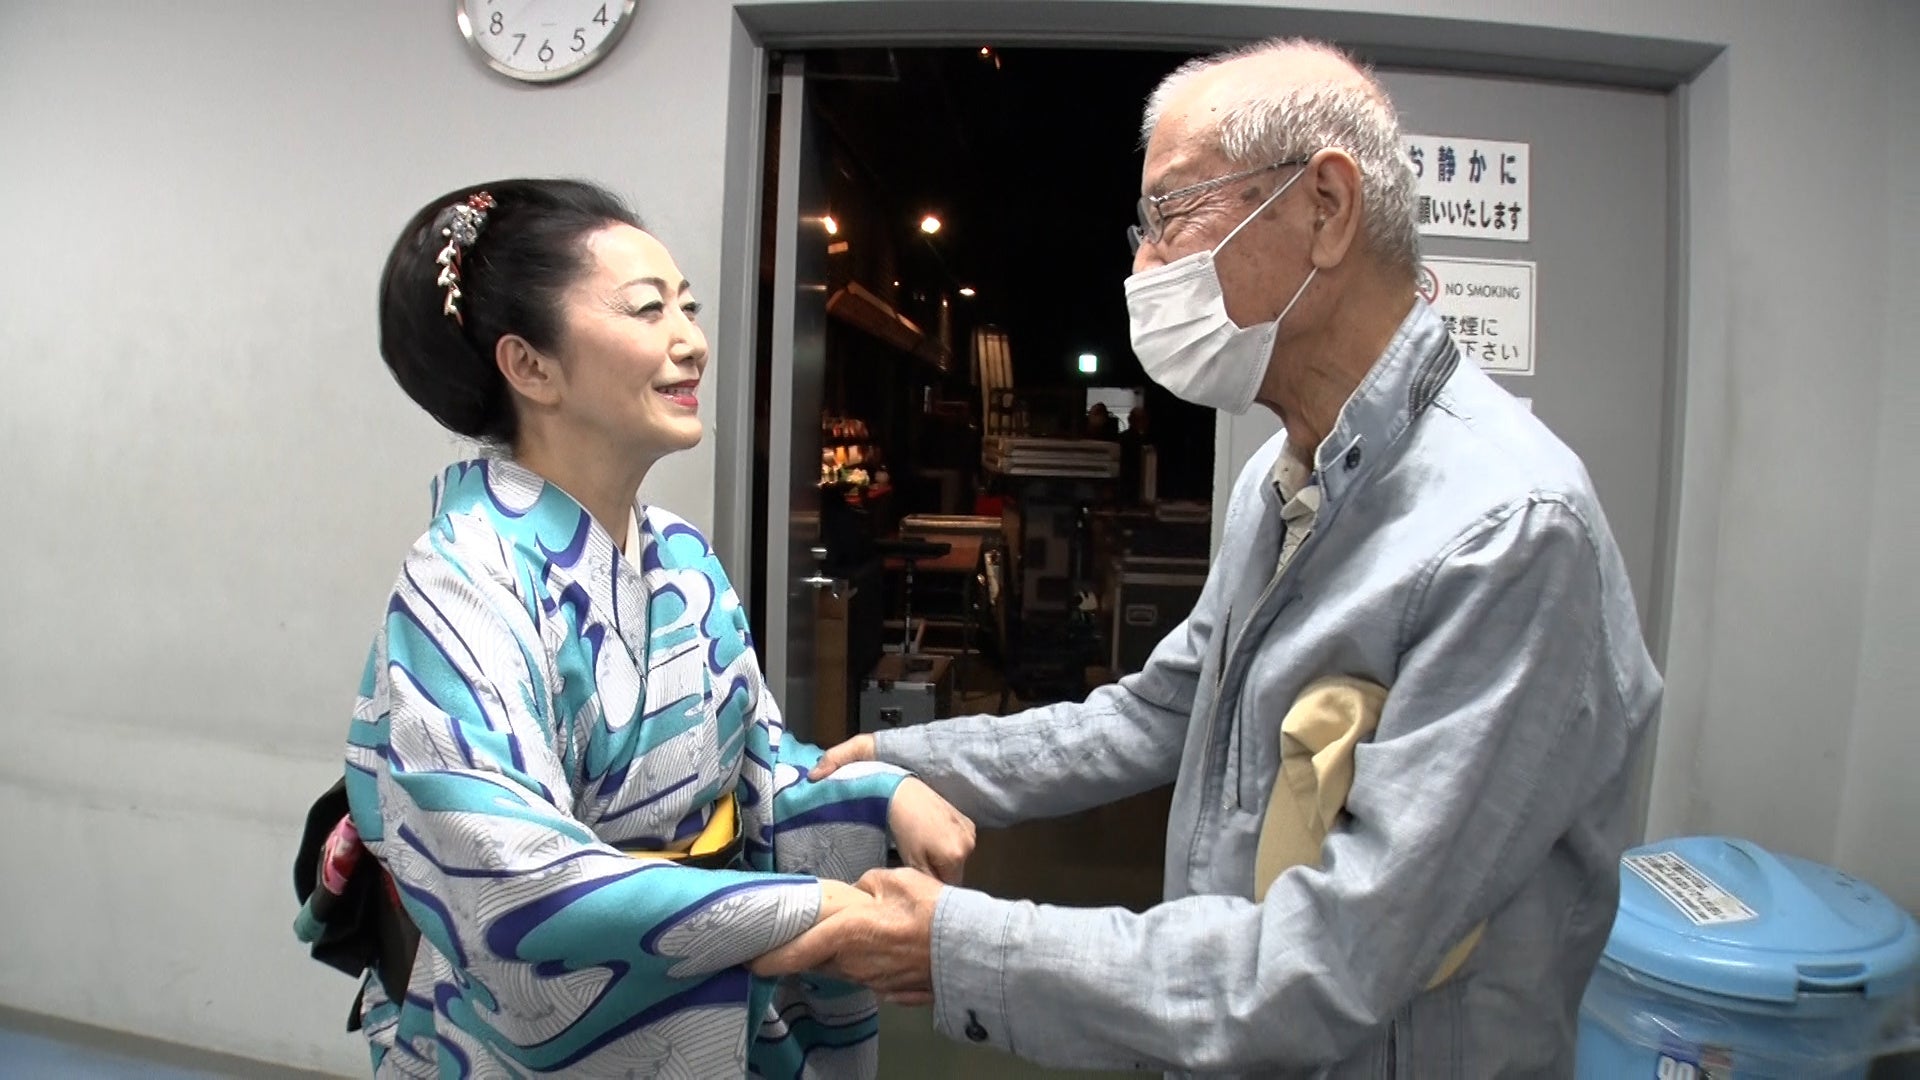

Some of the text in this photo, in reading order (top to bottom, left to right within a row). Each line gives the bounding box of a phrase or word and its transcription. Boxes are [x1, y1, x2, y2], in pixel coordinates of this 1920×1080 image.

[489, 11, 504, 36] 8
[592, 3, 608, 26] 4
[512, 33, 526, 56] 7
[537, 39, 554, 63] 6
[570, 28, 586, 52] 5
[1446, 283, 1521, 300] NO SMOKING
[1459, 340, 1519, 361] 下さい
